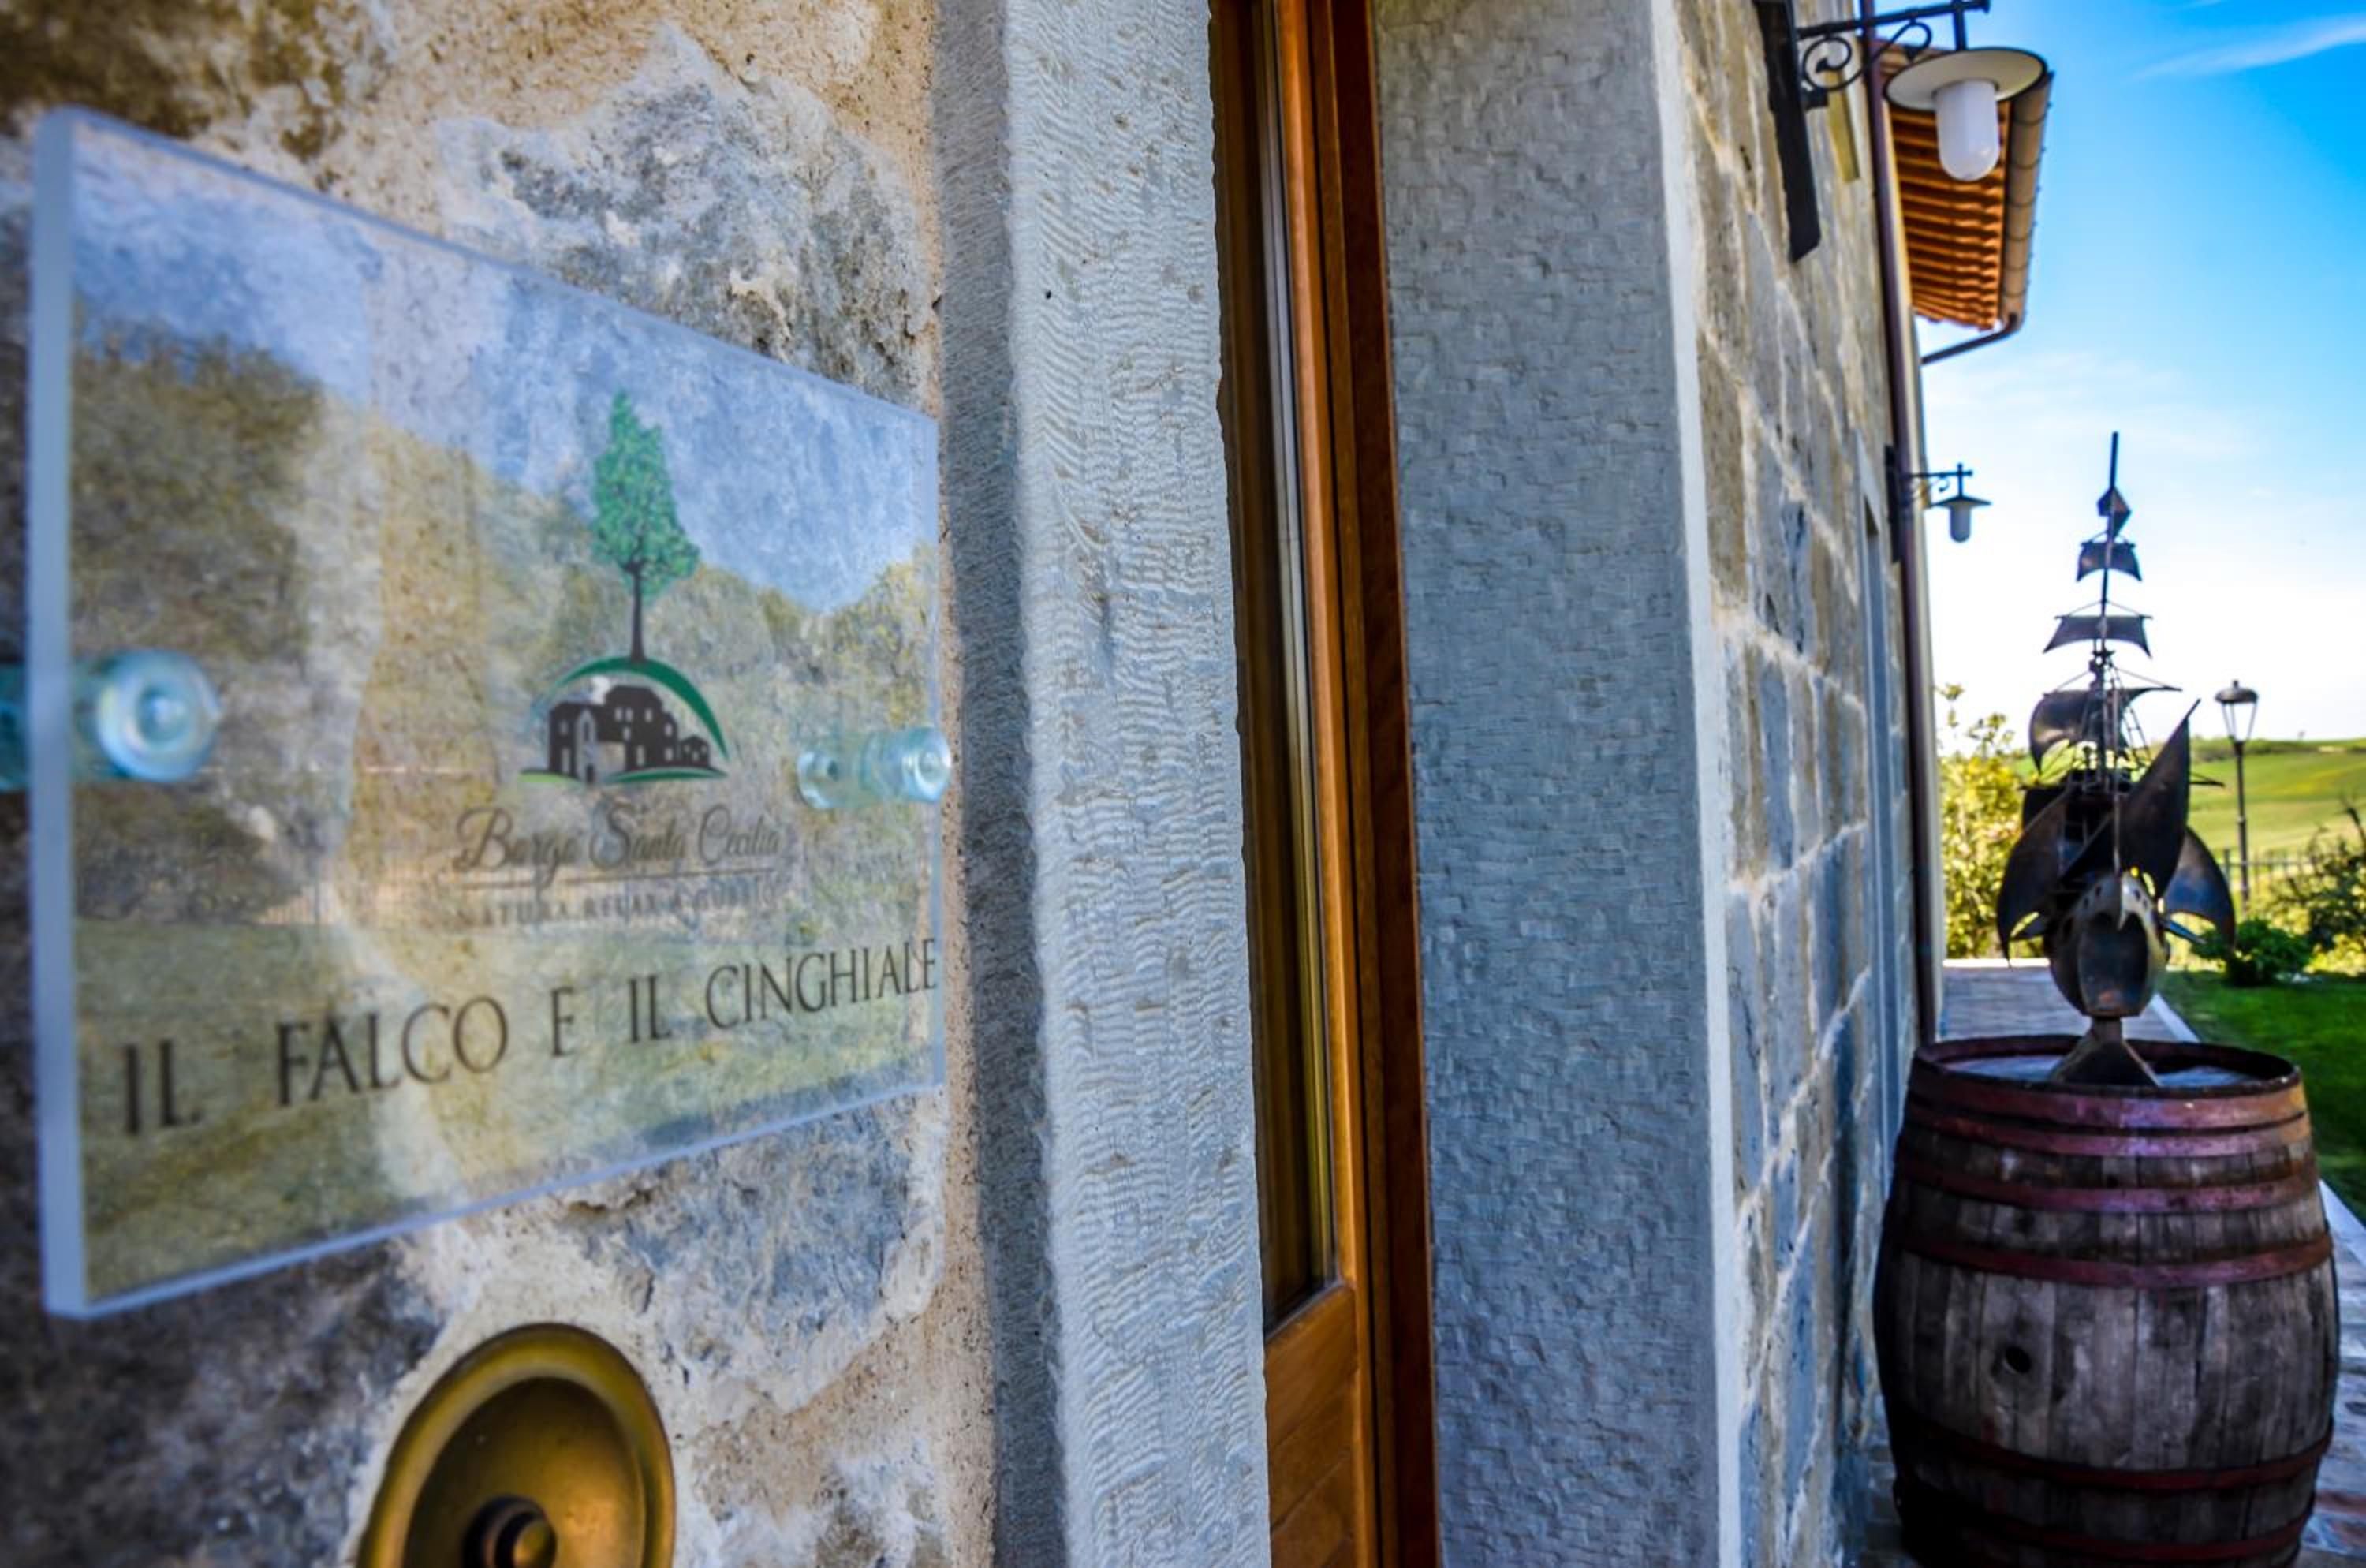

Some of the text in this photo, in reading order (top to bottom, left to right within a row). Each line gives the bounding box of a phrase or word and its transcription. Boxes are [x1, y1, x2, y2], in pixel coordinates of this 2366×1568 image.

[451, 801, 782, 891] Borgo Santa Cecilia
[123, 937, 939, 1136] IL FALCO E IL CINGHIALE
